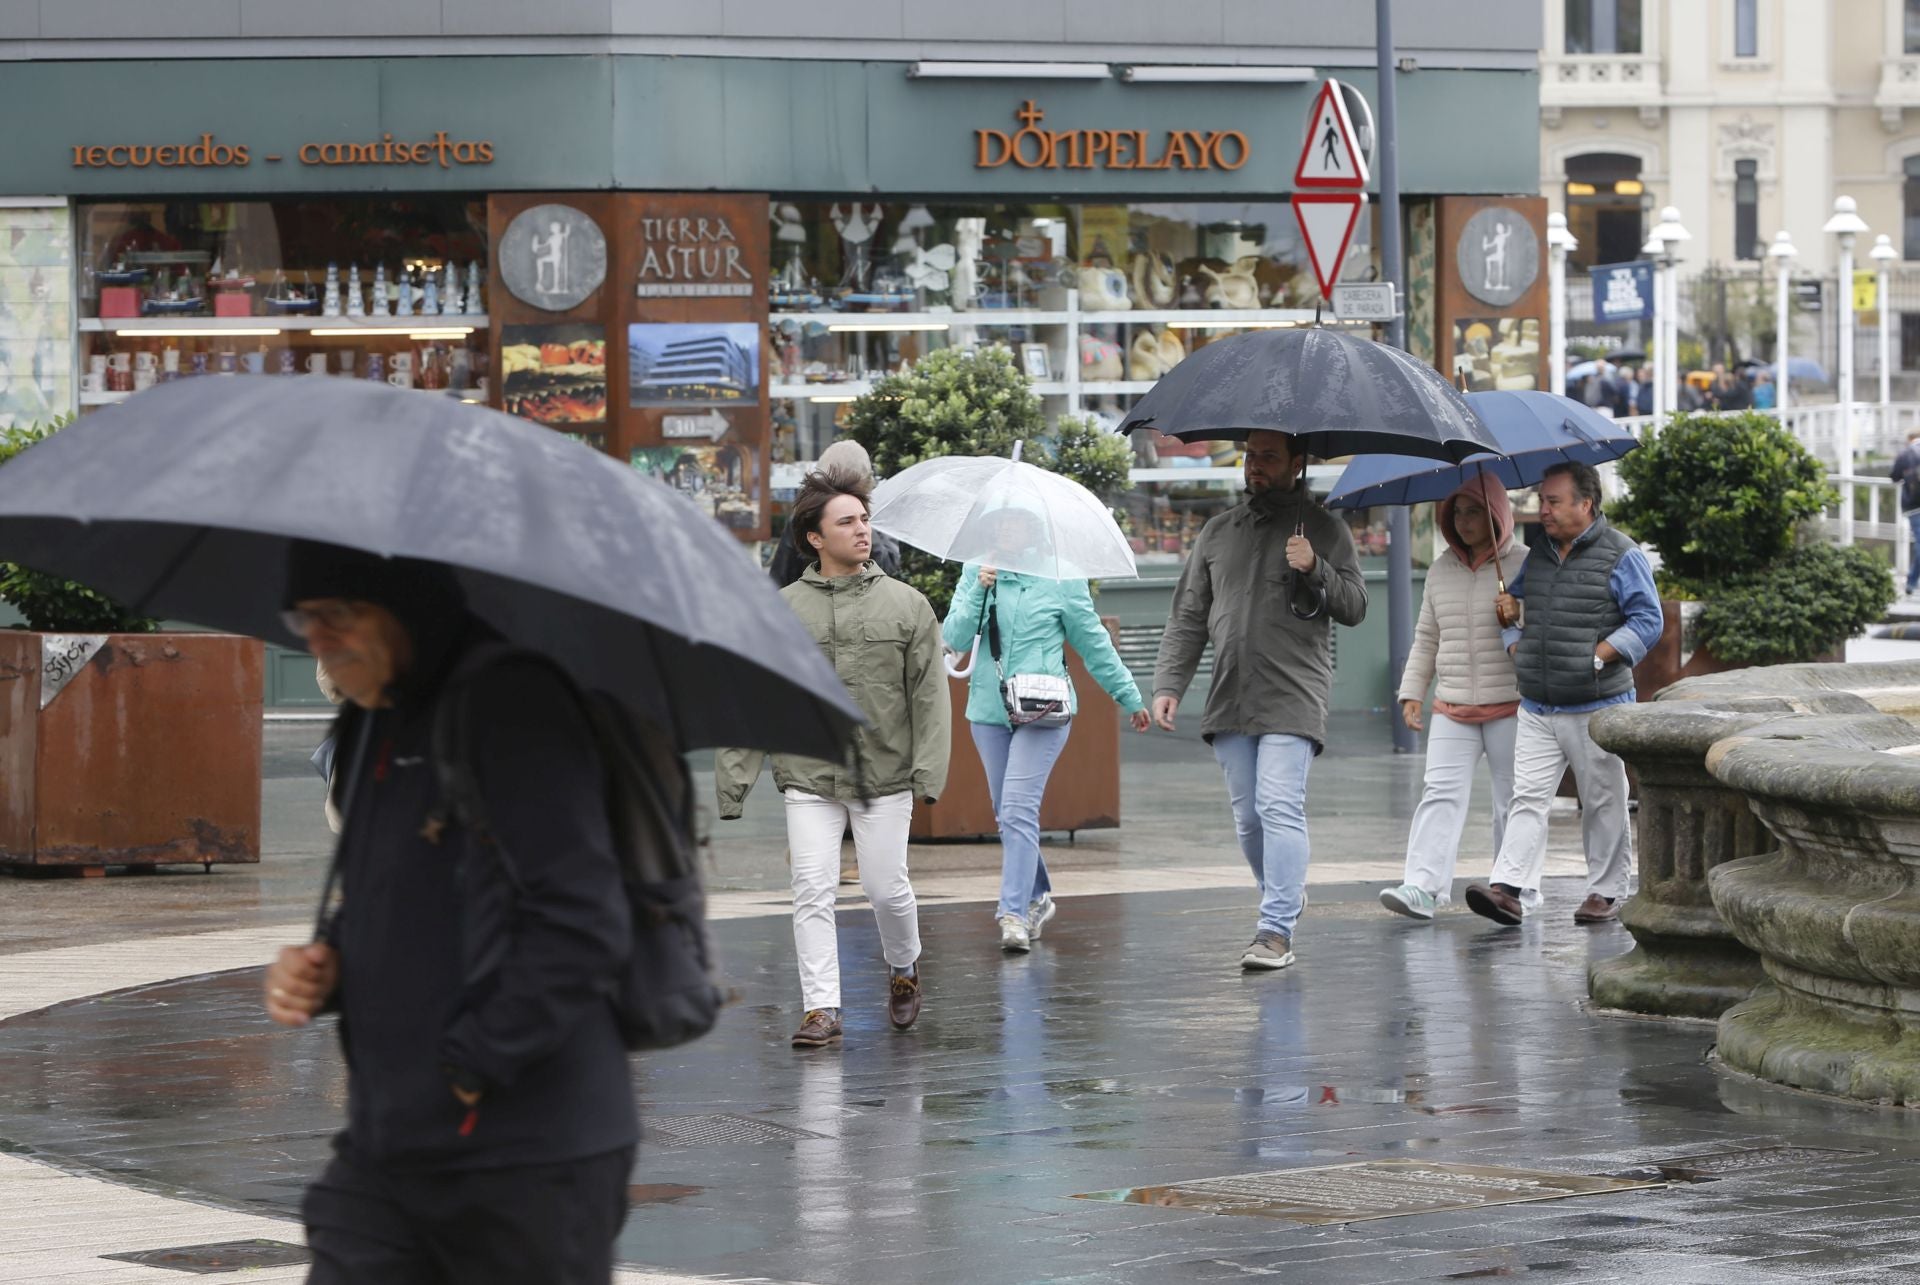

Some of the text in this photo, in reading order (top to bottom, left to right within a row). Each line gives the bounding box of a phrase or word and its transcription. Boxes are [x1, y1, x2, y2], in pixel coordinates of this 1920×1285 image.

[299, 131, 494, 169] camisetas
[641, 217, 736, 242] TIERRA
[638, 245, 752, 279] ASTUR
[1343, 289, 1382, 301] CABECERA
[1343, 303, 1385, 314] DE PARADA
